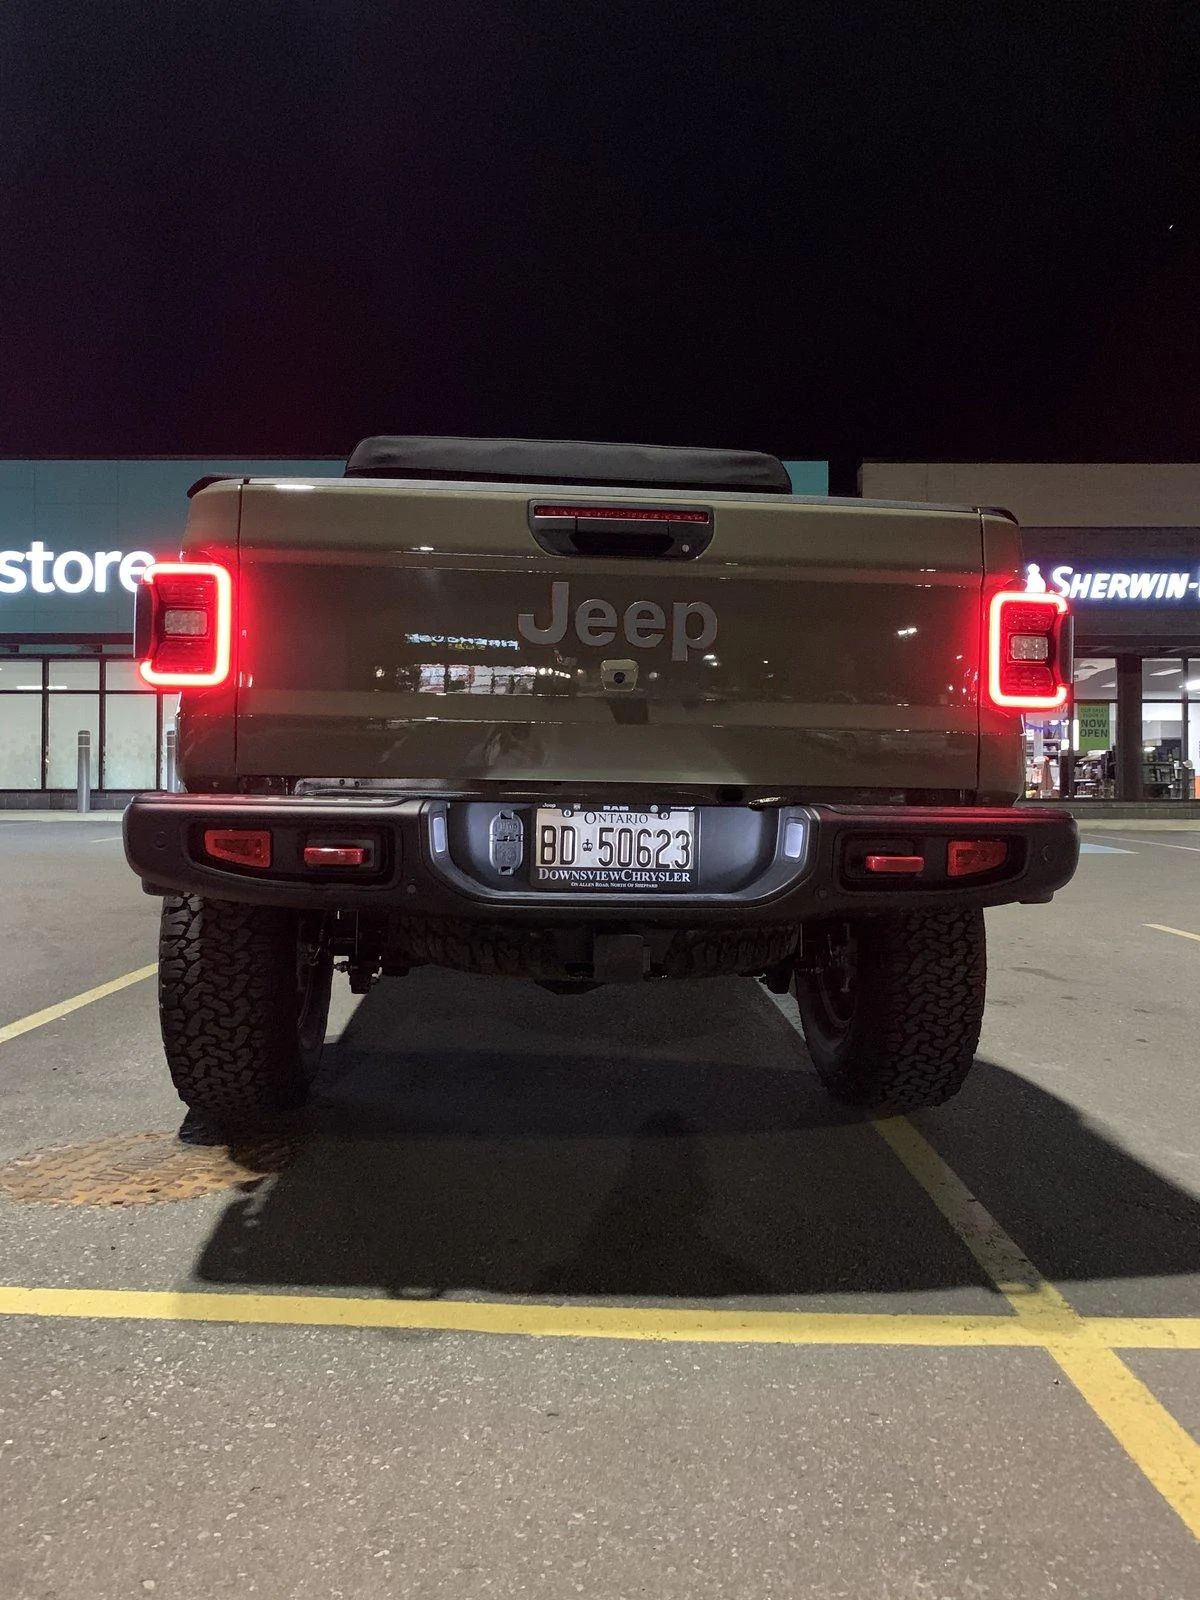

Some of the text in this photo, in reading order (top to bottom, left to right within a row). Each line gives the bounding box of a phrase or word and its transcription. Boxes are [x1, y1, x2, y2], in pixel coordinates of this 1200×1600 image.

[0, 541, 156, 593] store
[1050, 566, 1200, 599] SHERWIN-
[518, 581, 718, 662] Jeep
[1080, 719, 1107, 728] NOW
[1080, 728, 1108, 738] OPEN
[584, 812, 648, 825] ONTARIO
[541, 825, 691, 869] BD 50623
